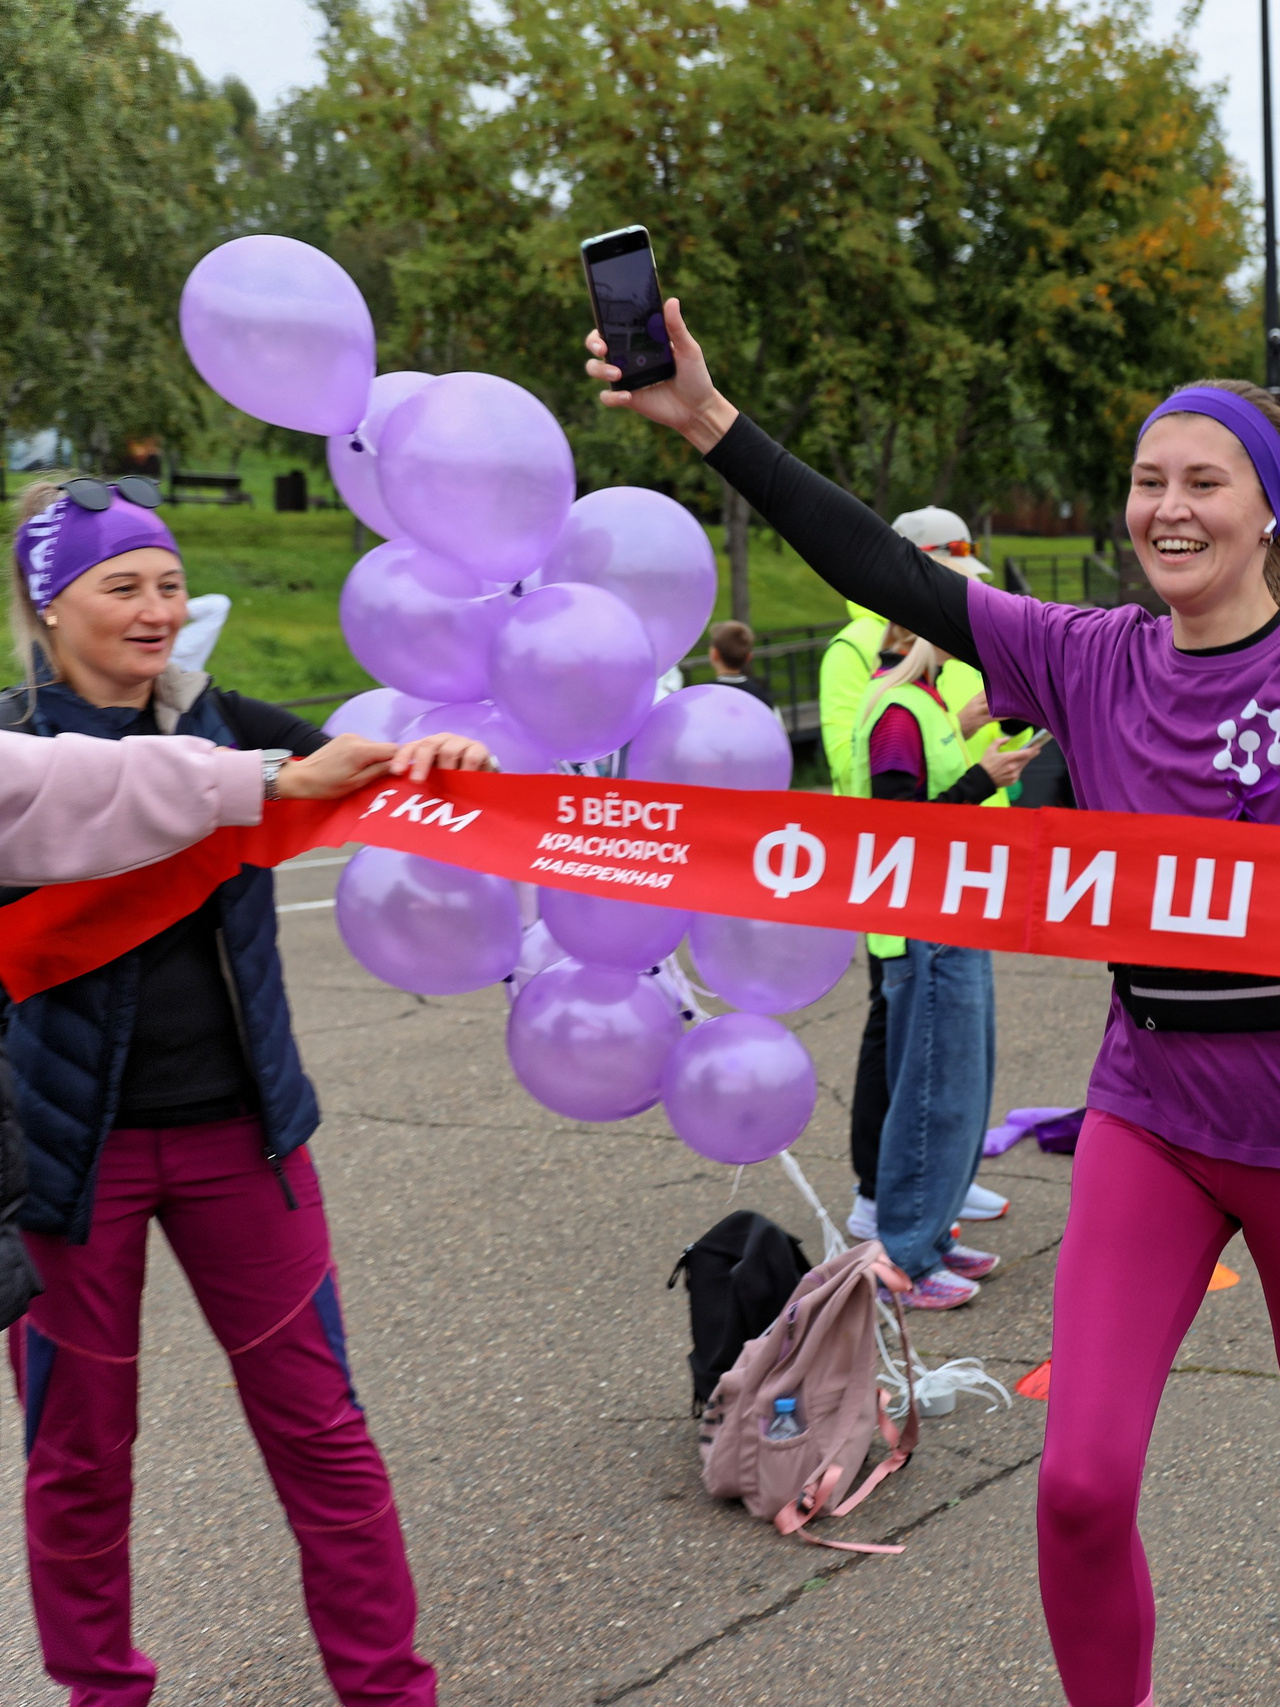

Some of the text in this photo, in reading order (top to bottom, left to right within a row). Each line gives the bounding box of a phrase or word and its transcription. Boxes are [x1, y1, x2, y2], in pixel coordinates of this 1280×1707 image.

[359, 788, 483, 833] 5 КМ
[557, 791, 684, 832] 5 ВЁРСТ
[537, 832, 690, 865] КРАСНОЯРСК
[530, 857, 675, 889] НАБЕРЕЖНАЯ
